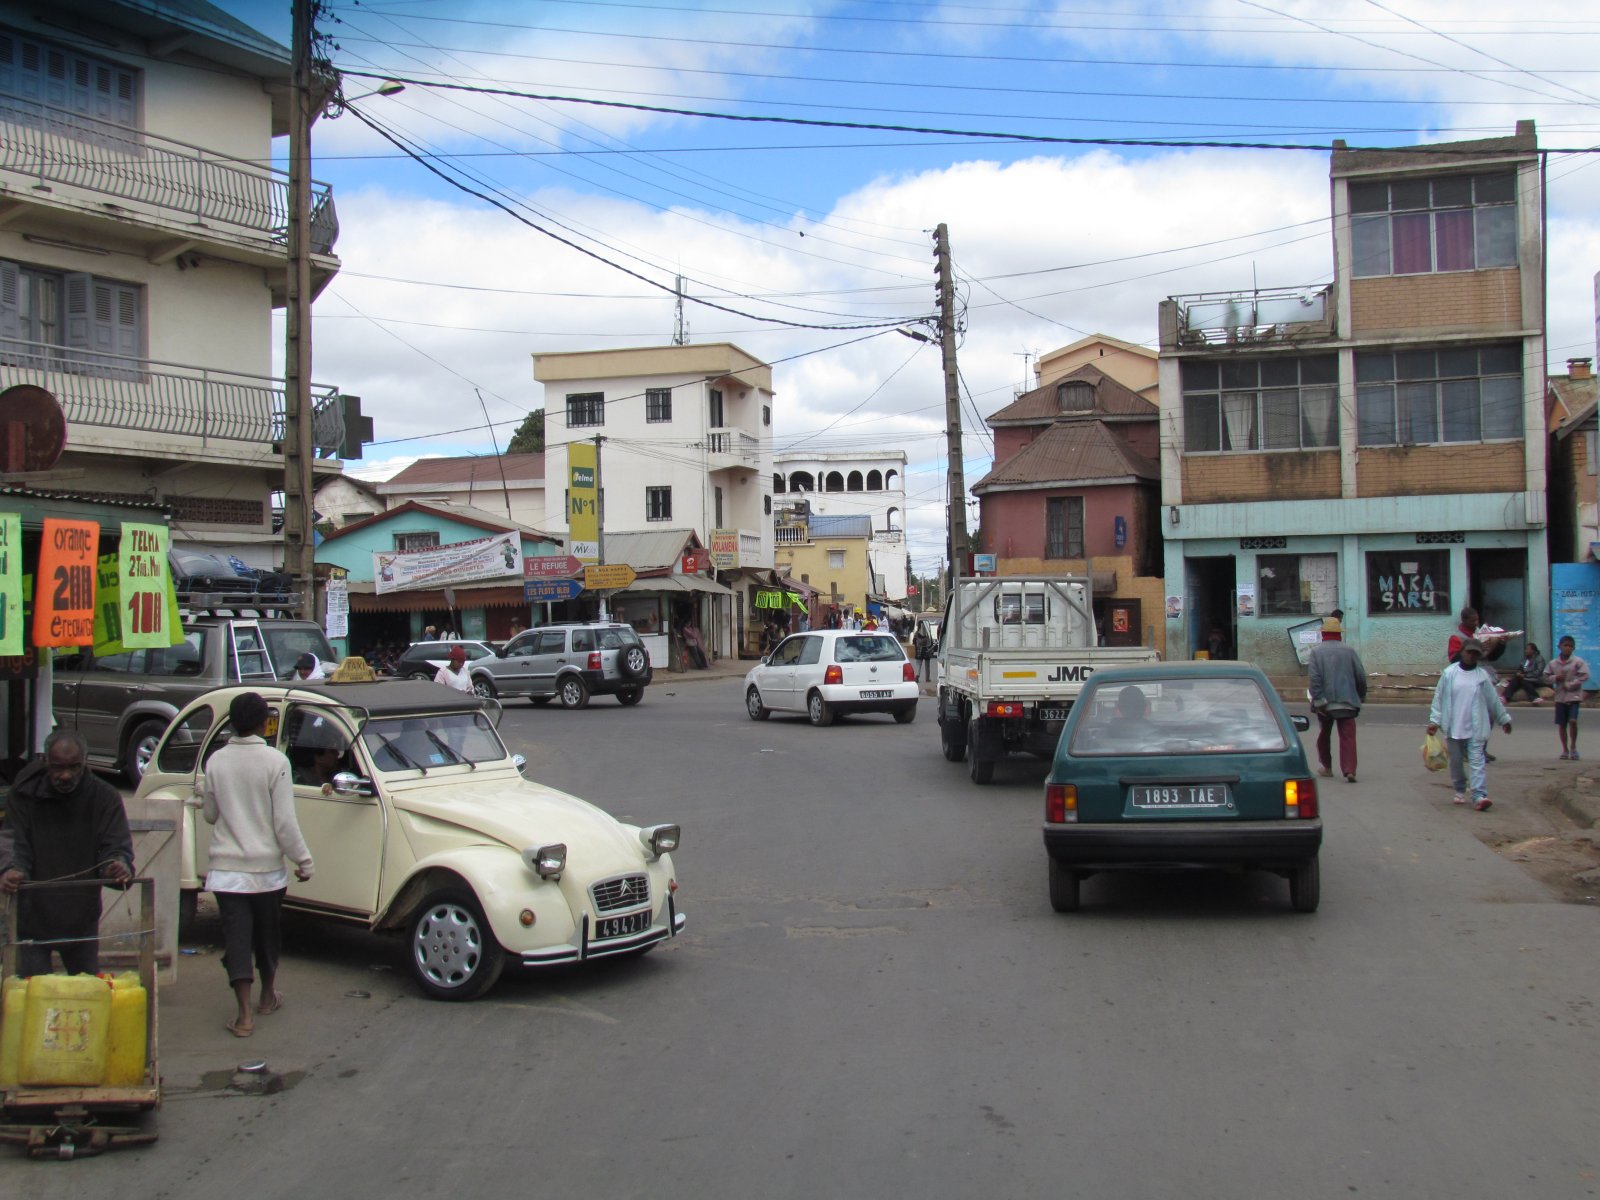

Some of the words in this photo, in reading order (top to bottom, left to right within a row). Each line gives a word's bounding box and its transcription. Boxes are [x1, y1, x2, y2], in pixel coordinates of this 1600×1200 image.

[131, 529, 160, 552] TELMA
[529, 562, 539, 571] LE
[541, 561, 568, 570] REFUGE
[1379, 574, 1434, 592] MAKA
[1382, 591, 1436, 611] SARY
[1047, 666, 1095, 681] JMC
[1044, 710, 1066, 719] 3622
[1145, 788, 1179, 803] 1893
[1189, 788, 1215, 803] TAE
[603, 916, 635, 937] 4942
